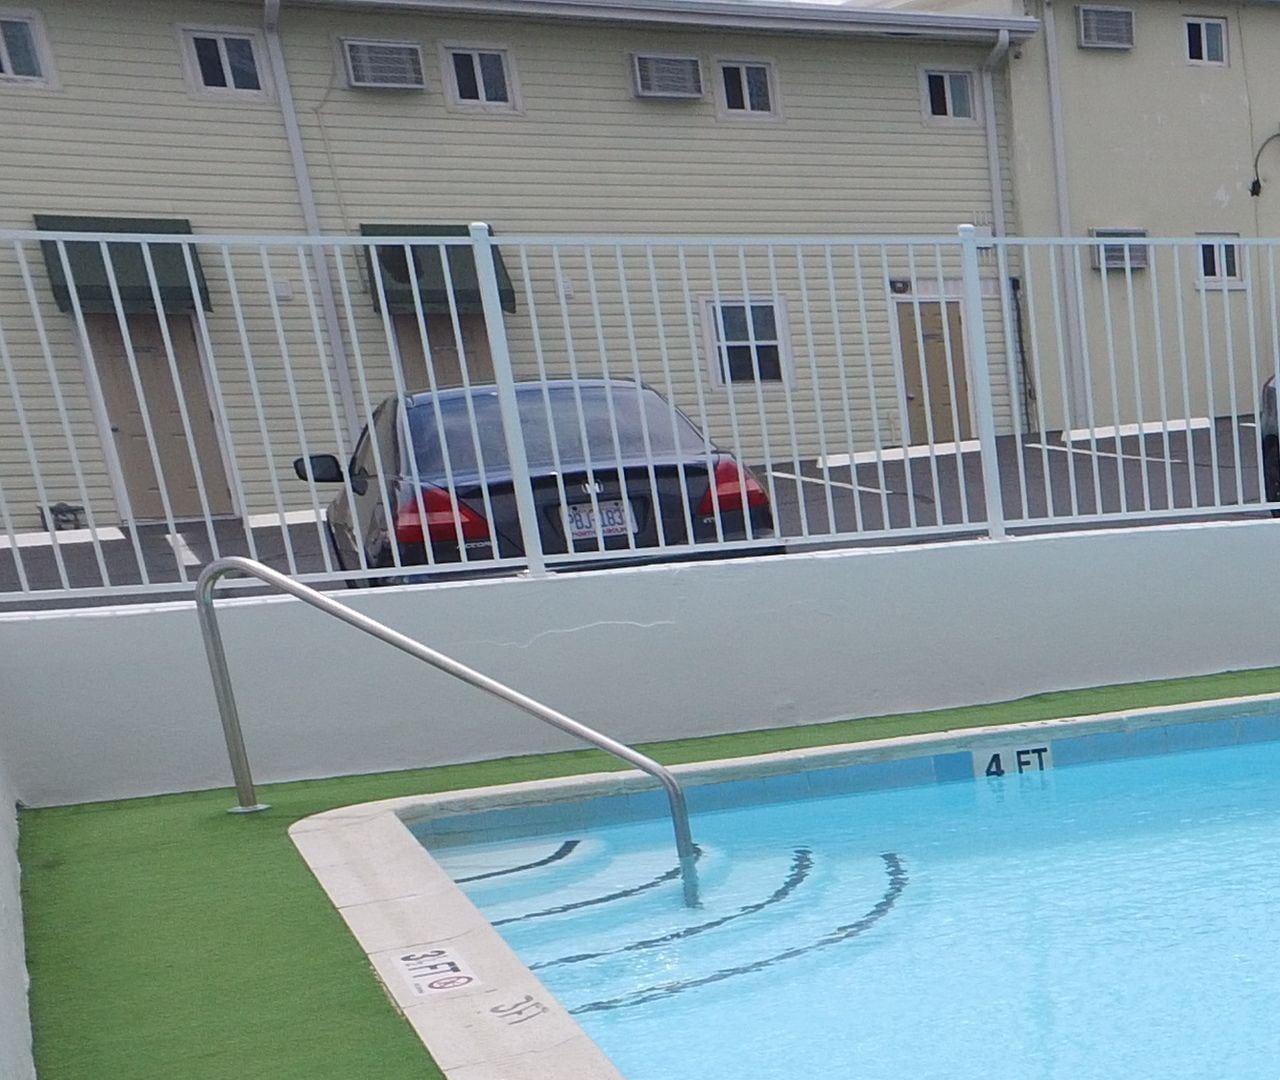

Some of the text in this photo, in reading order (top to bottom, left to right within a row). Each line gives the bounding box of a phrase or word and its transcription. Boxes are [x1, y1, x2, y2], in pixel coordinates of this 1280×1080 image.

[985, 747, 1048, 777] 4 FT
[408, 961, 461, 978] FT
